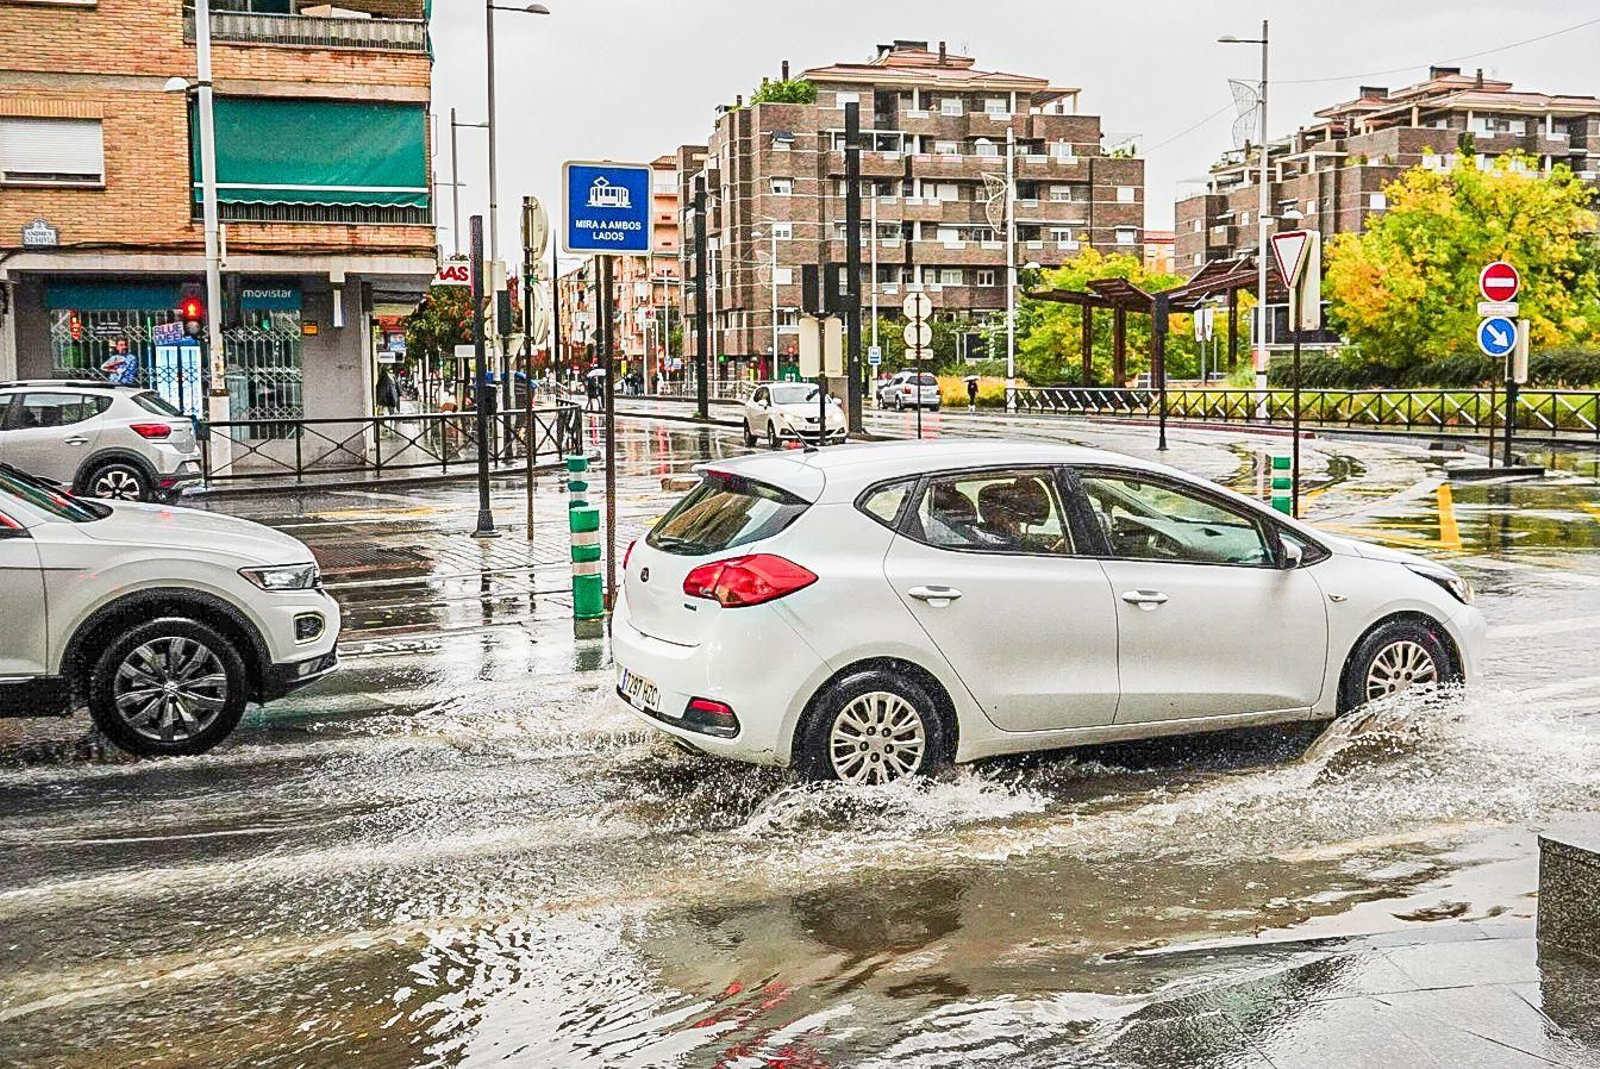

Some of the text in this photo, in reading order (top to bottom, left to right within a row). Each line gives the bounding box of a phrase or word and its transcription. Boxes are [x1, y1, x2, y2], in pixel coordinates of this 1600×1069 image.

[575, 219, 641, 231] MIRA A AMBOS
[592, 231, 625, 241] LADOS
[242, 288, 292, 299] movistar
